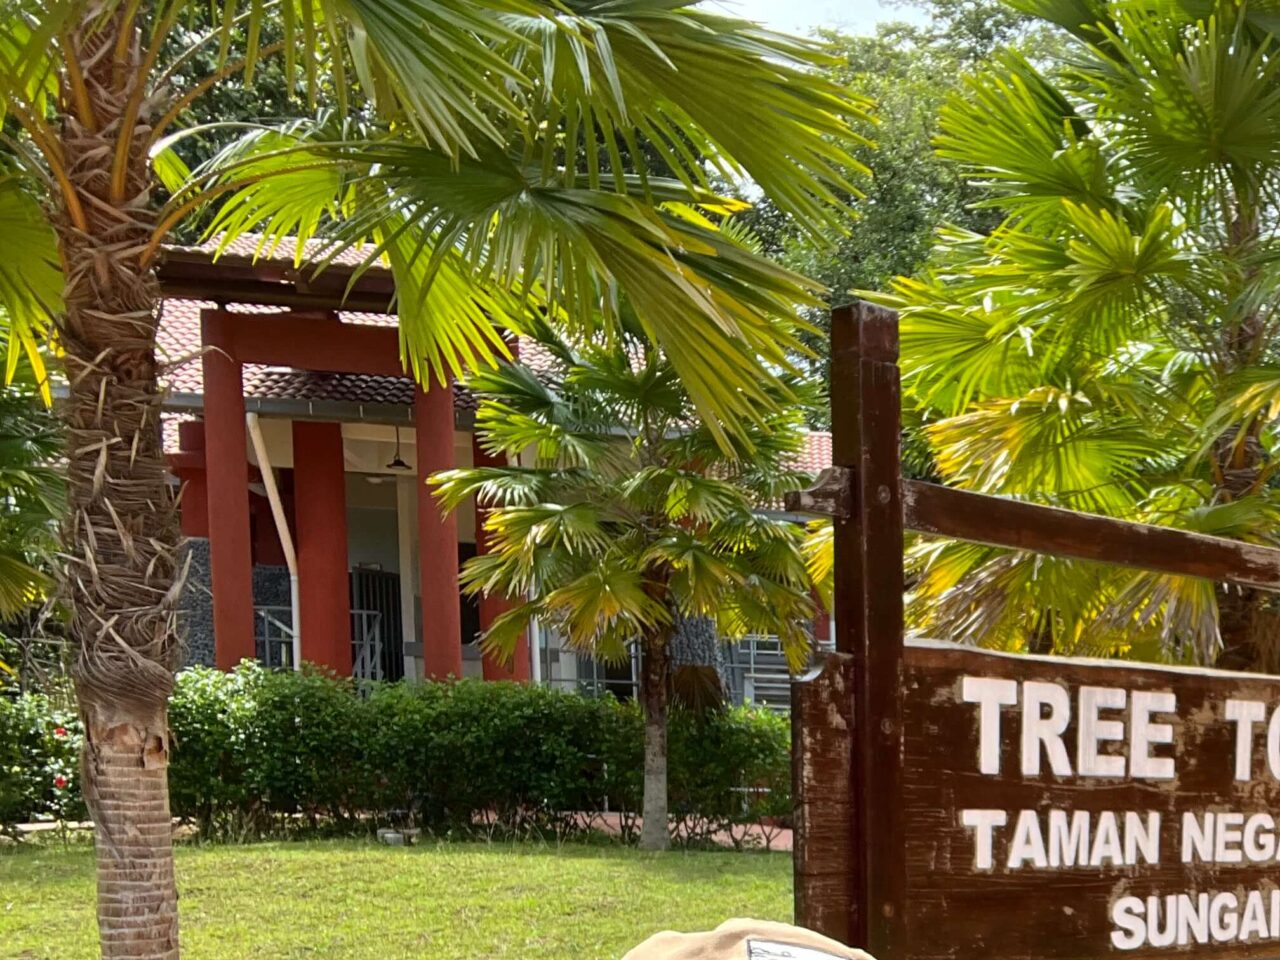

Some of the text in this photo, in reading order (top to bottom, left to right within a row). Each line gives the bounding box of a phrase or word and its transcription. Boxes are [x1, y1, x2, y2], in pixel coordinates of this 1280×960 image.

[963, 677, 1177, 778] TREE
[962, 809, 1160, 868] TAMAN
[1110, 889, 1280, 950] SUNGAI
